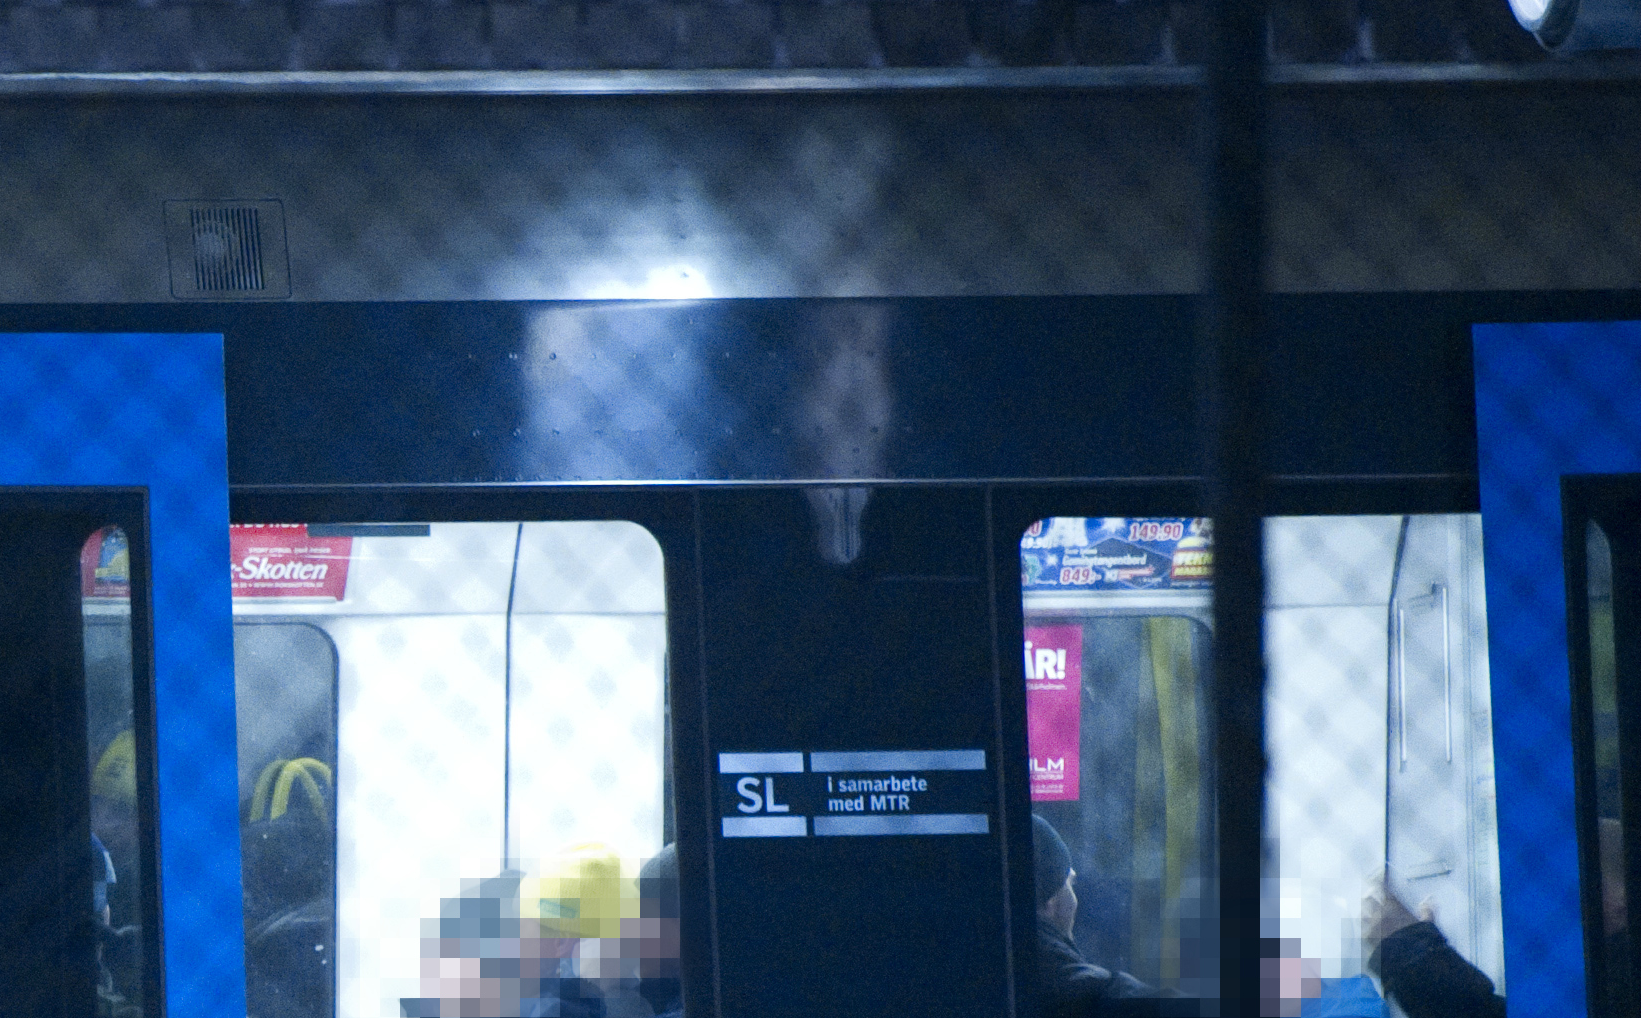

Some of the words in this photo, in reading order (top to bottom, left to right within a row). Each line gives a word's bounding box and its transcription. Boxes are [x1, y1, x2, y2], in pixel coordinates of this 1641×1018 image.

[827, 776, 833, 793] i
[838, 775, 928, 793] samarbete
[736, 776, 790, 813] SL
[828, 795, 865, 811] med
[870, 795, 910, 811] MTR
